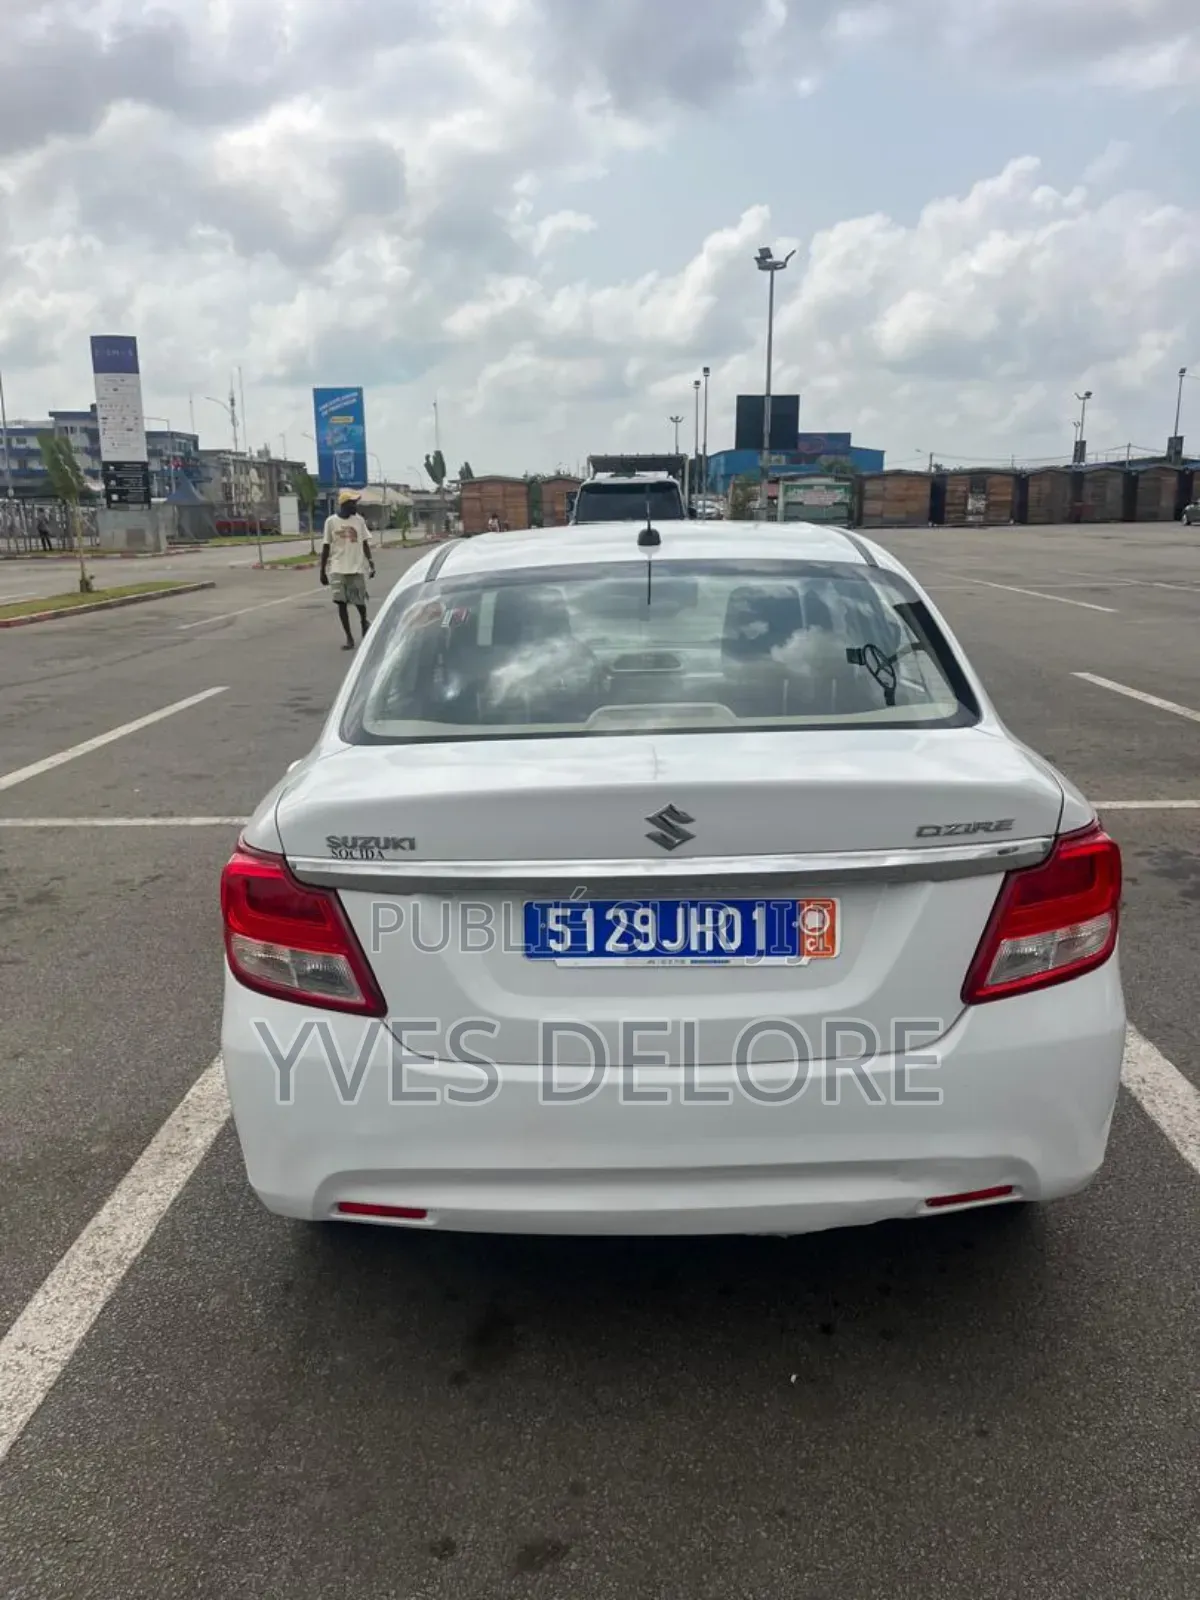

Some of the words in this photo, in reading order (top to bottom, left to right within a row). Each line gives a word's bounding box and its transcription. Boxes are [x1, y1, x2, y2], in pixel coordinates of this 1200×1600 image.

[326, 835, 416, 850] SUZUKI
[331, 848, 385, 860] SOCIDA
[547, 907, 766, 952] 5129JH01
